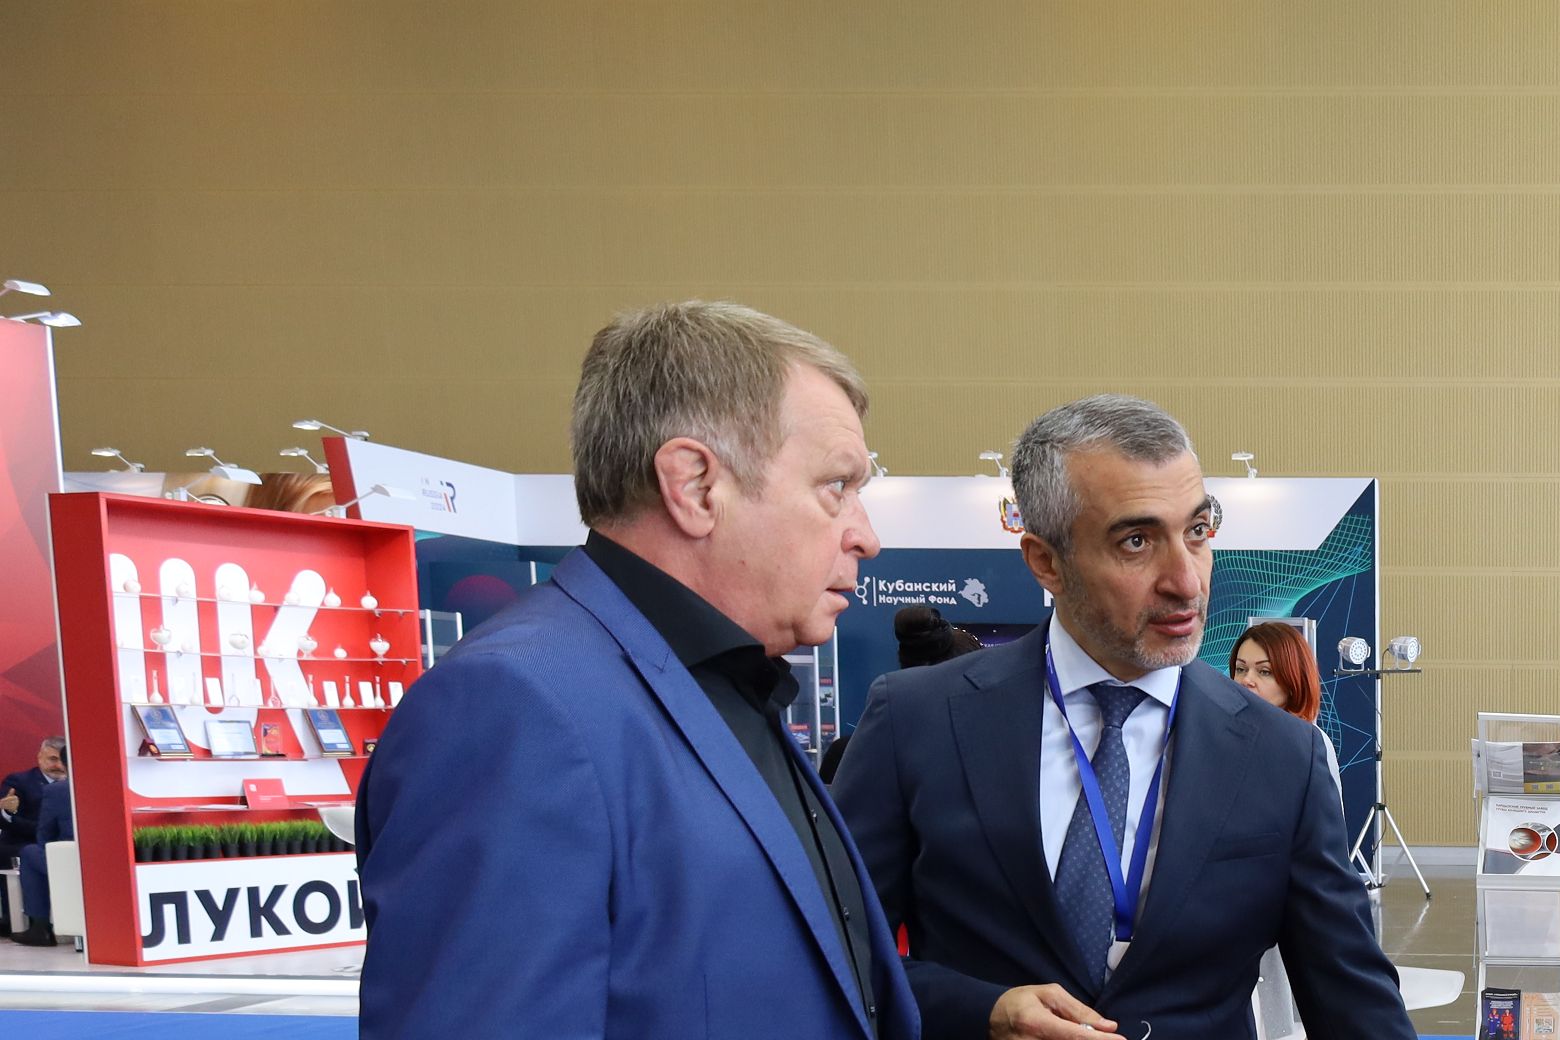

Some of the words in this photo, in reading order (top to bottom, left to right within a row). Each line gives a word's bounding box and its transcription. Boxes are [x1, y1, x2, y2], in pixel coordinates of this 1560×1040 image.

[878, 579, 956, 594] Кубанский
[878, 594, 926, 606] Научный
[928, 594, 957, 605] Фонд
